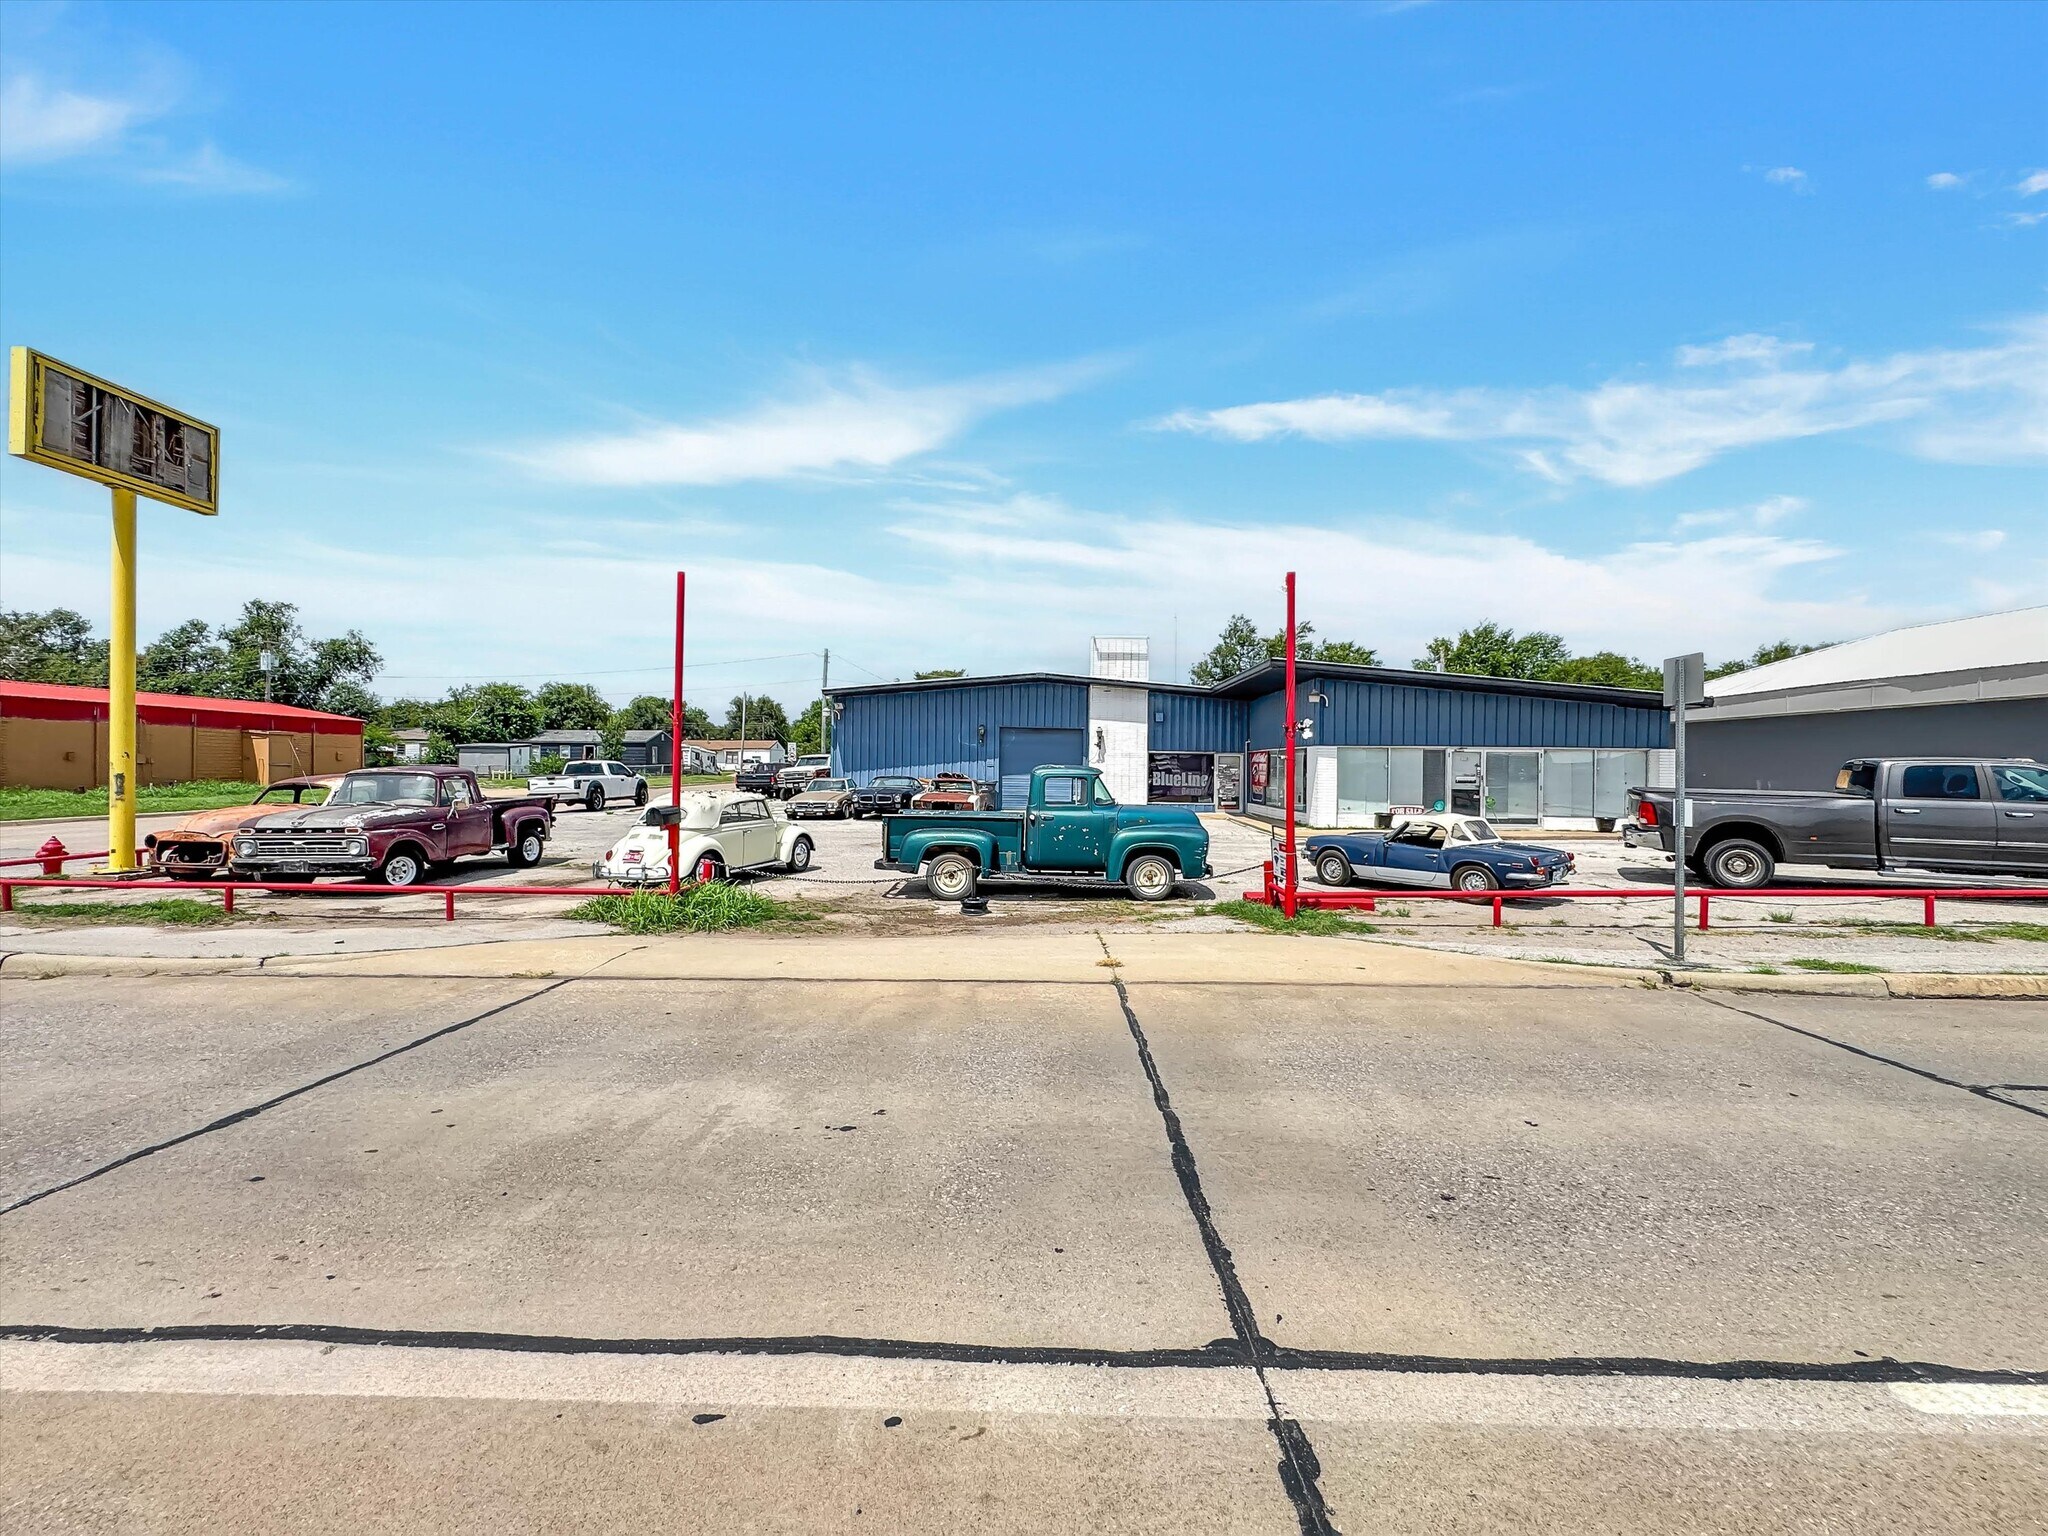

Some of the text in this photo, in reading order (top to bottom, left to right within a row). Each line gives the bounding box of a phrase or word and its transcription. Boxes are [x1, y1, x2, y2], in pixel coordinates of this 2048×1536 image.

[1152, 771, 1209, 787] BlueLine
[1391, 807, 1423, 815] FOR SALE
